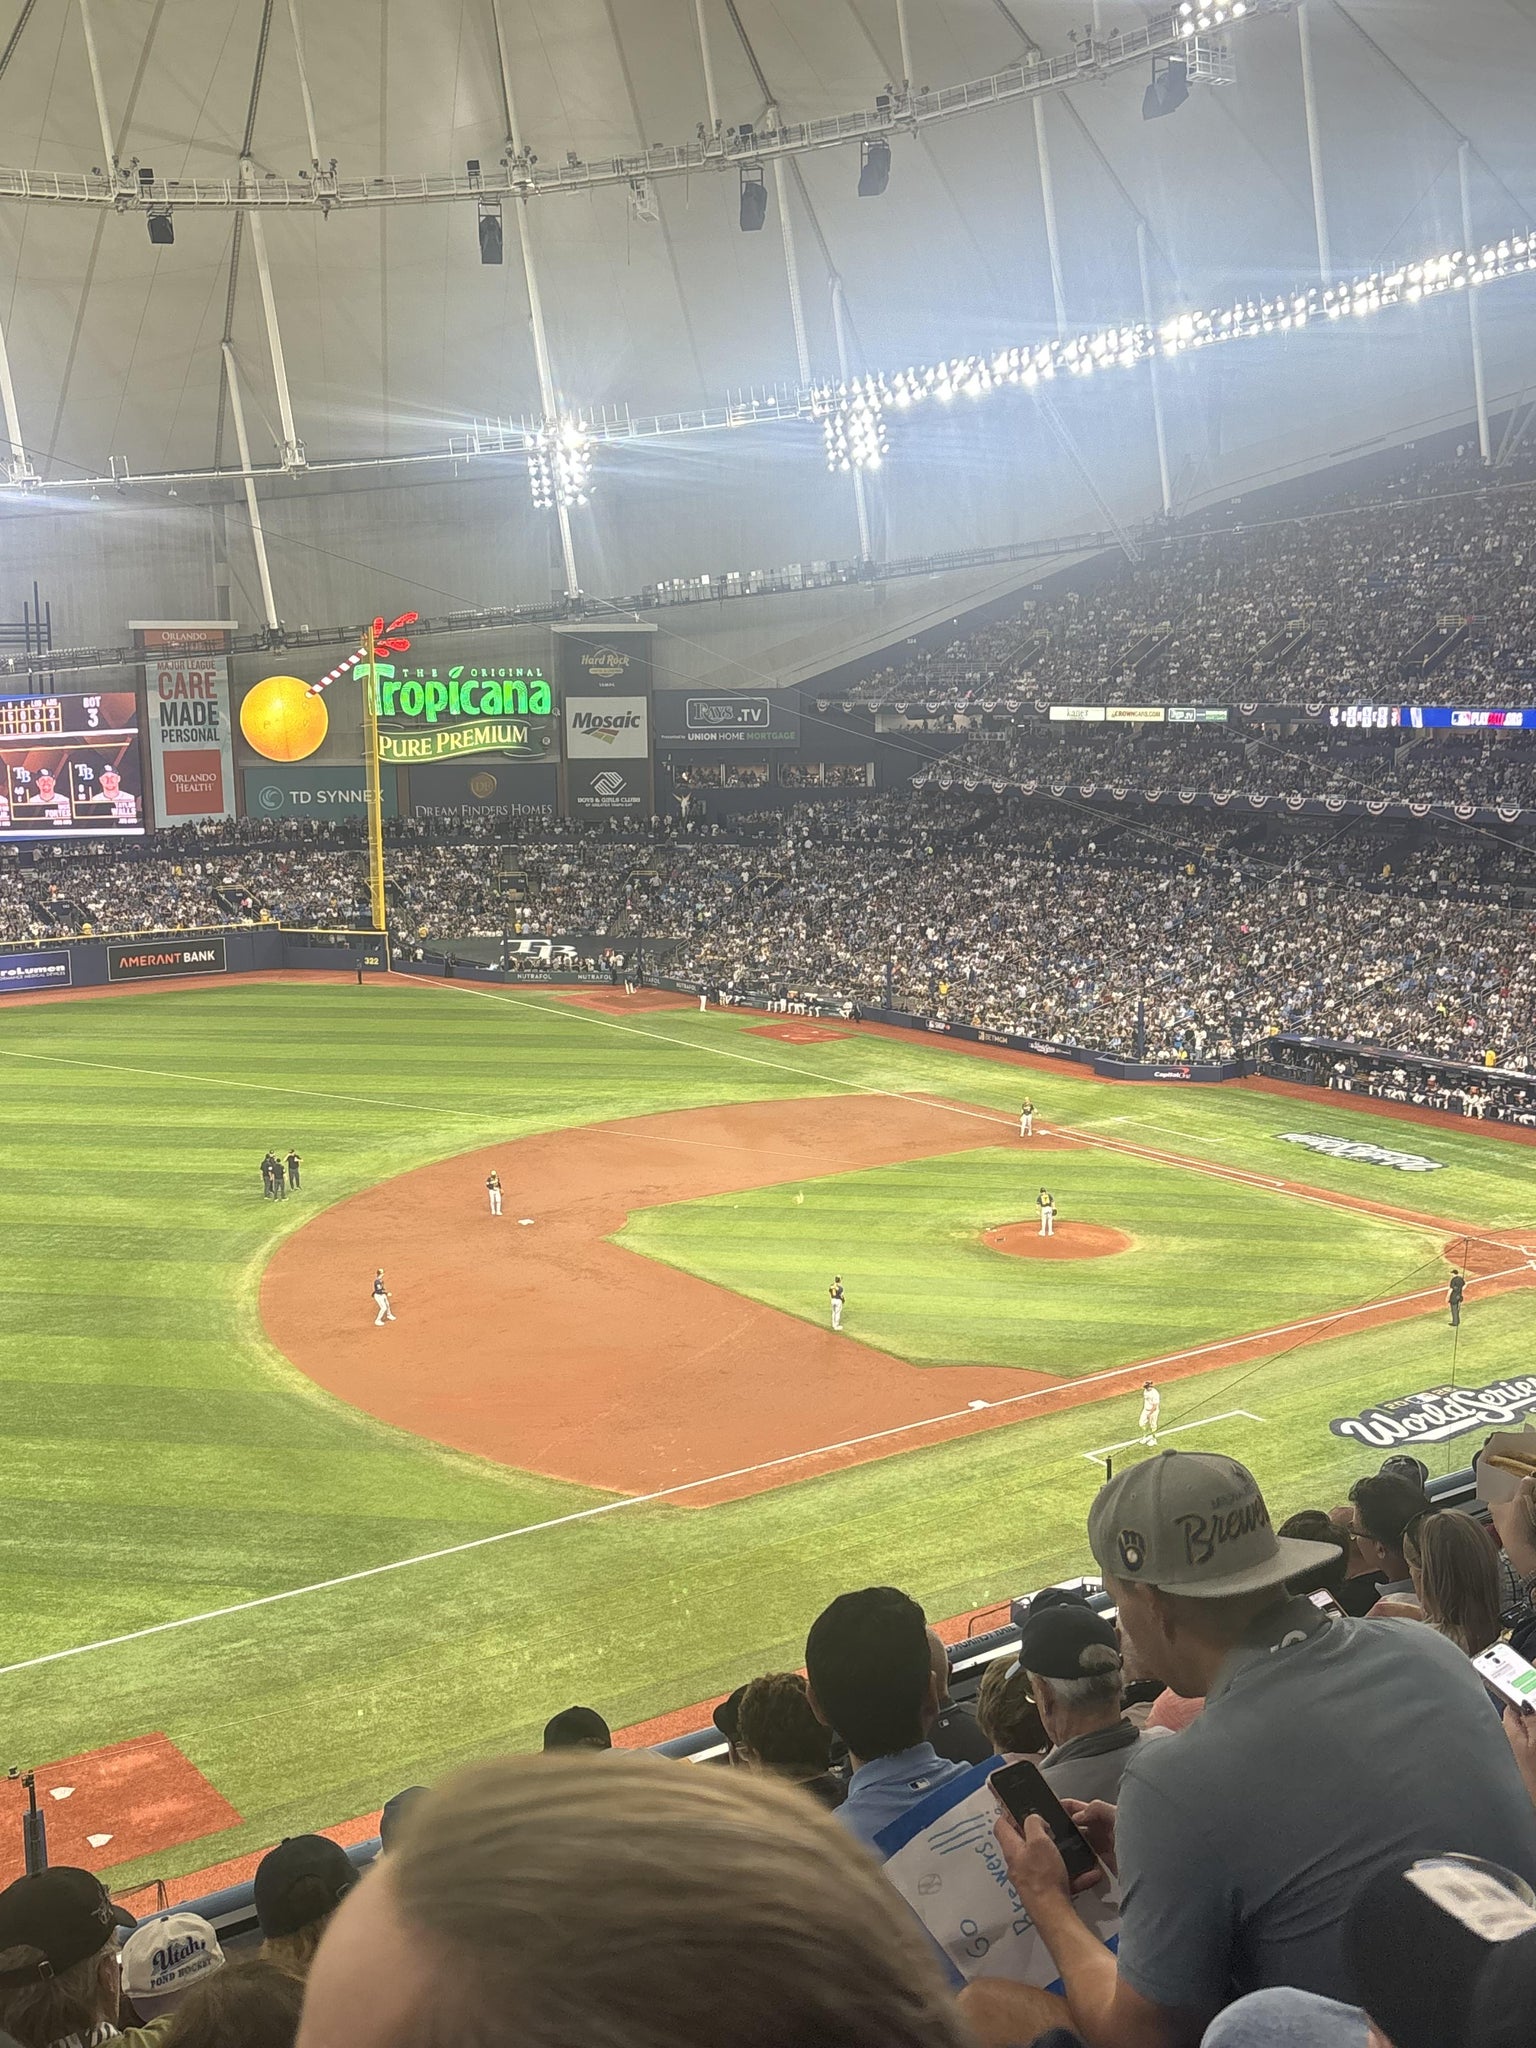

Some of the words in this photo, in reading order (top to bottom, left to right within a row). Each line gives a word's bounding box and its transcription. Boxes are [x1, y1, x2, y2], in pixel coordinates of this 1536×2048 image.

[162, 632, 207, 641] ORLANDO
[157, 660, 185, 670] MAJOR
[187, 660, 215, 670] LEAGUE
[581, 655, 605, 665] Hard
[607, 654, 630, 667] Rock
[402, 669, 438, 678] THE
[470, 668, 543, 677] ORIGINAL
[158, 672, 218, 700] CARE
[353, 664, 551, 722] Tropicana
[88, 708, 99, 728] 3
[160, 701, 220, 727] MADE
[572, 711, 641, 729] Mosaic
[161, 728, 220, 743] PERSONAL
[379, 735, 433, 758] PURE
[437, 726, 529, 753] PREMIUM
[688, 733, 717, 741] UNION
[719, 732, 745, 740] HOME
[747, 732, 796, 740] MORTGAGE
[13, 766, 31, 783] TB
[75, 763, 95, 781] TB
[170, 773, 217, 783] ORLANDO
[176, 783, 213, 792] HEALTH
[289, 791, 312, 804] TD
[316, 789, 385, 803] SYNNEX
[415, 805, 458, 818] DREAM
[461, 804, 508, 817] FINDERS
[512, 803, 553, 815] HOMES
[119, 953, 182, 969] AMERANT
[183, 950, 216, 963] BANK
[364, 957, 379, 965] 322
[1340, 1393, 1476, 1446] World
[150, 1972, 175, 1988] POND
[178, 1958, 211, 1978] HOCKEY
